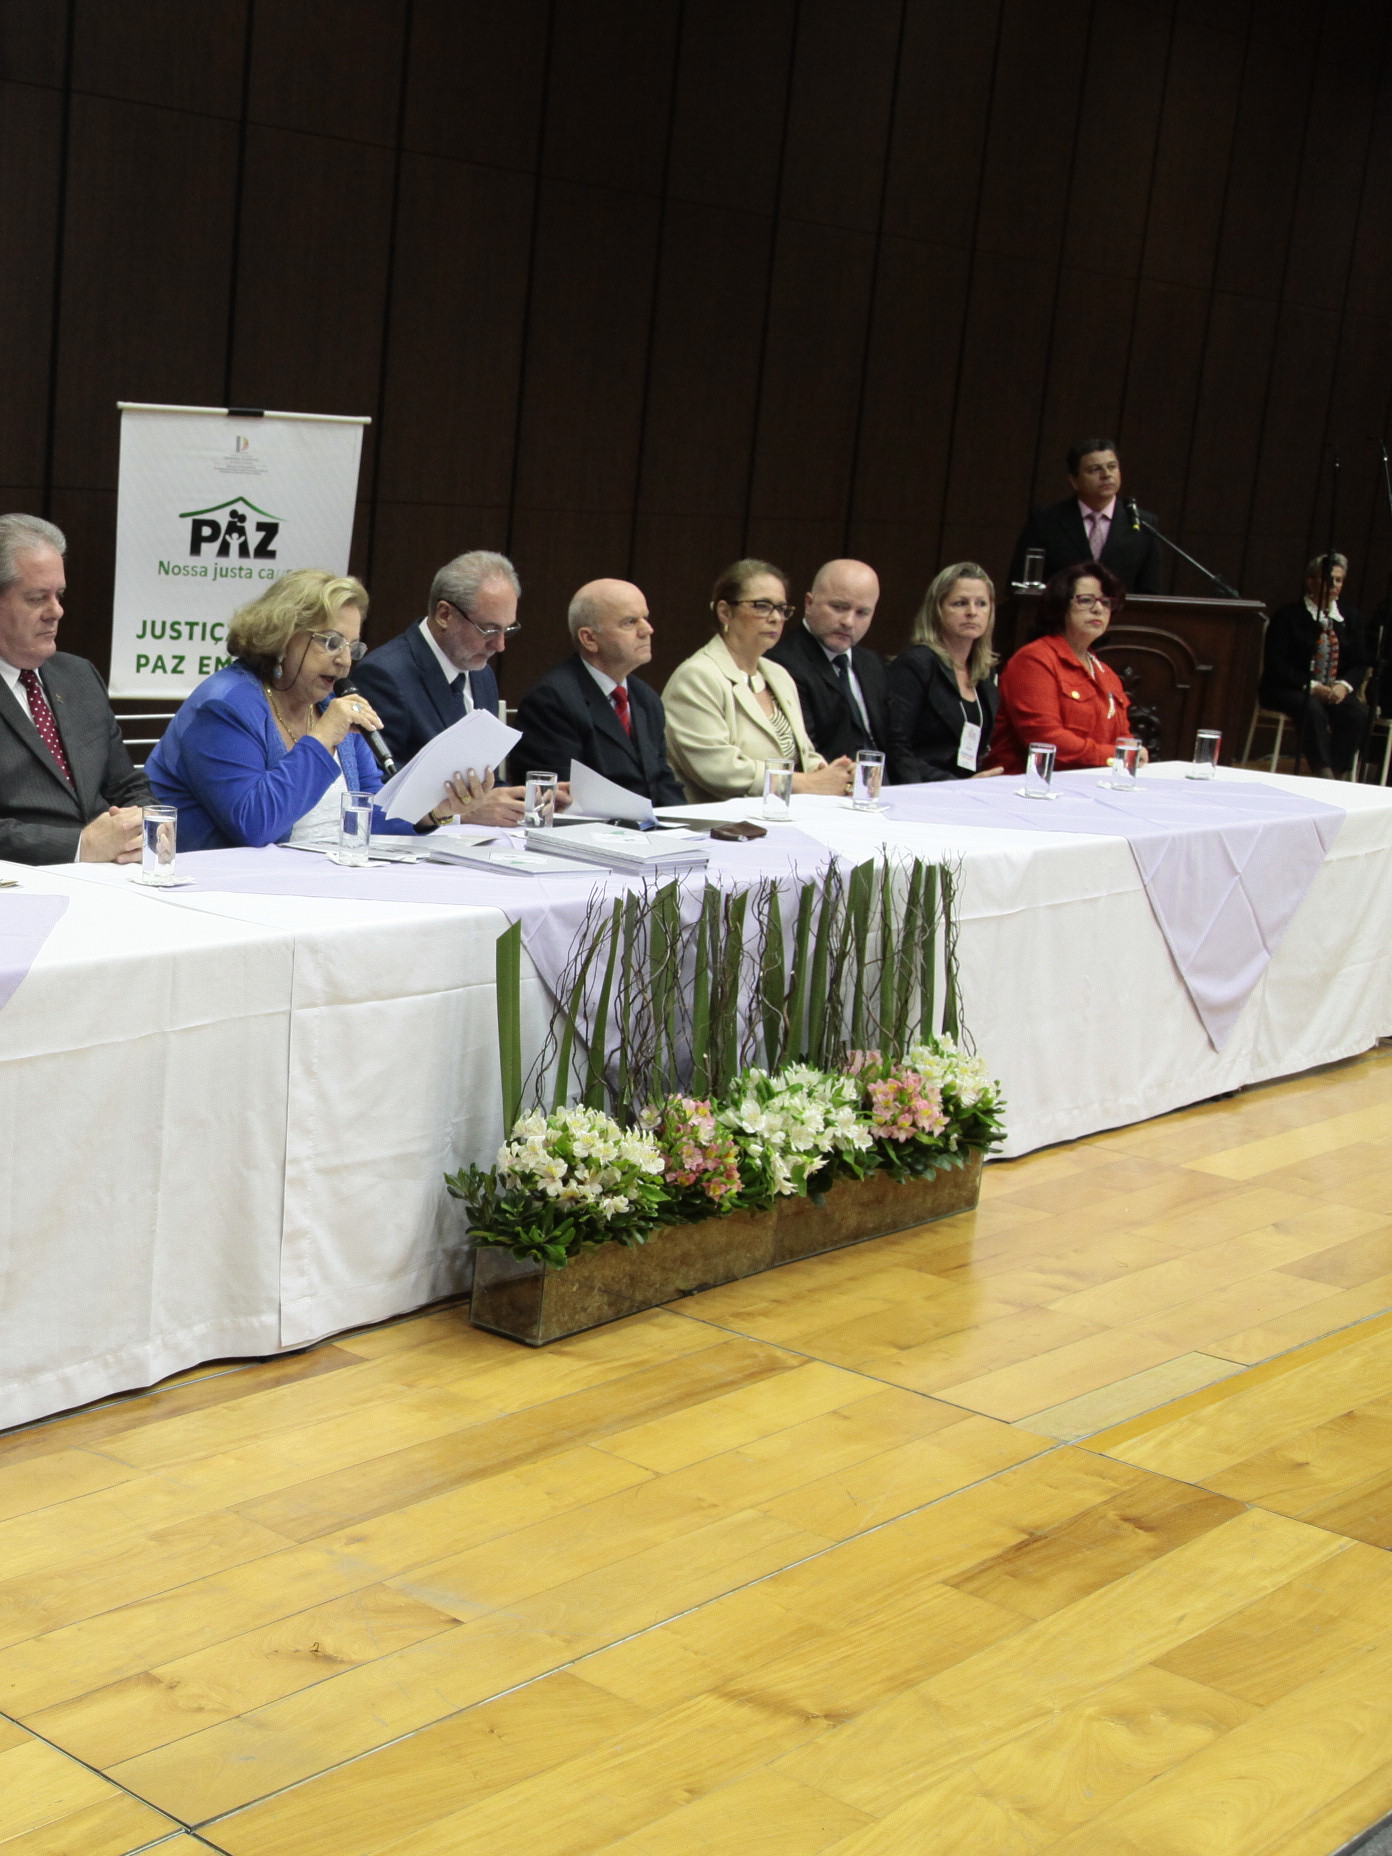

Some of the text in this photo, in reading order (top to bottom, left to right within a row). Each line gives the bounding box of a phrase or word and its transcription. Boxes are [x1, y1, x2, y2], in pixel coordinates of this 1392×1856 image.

[189, 517, 279, 560] PAZ
[158, 560, 208, 577] Nossa
[212, 562, 253, 581] justa
[136, 619, 228, 645] JUSTIÇ
[136, 653, 186, 675] PAZ
